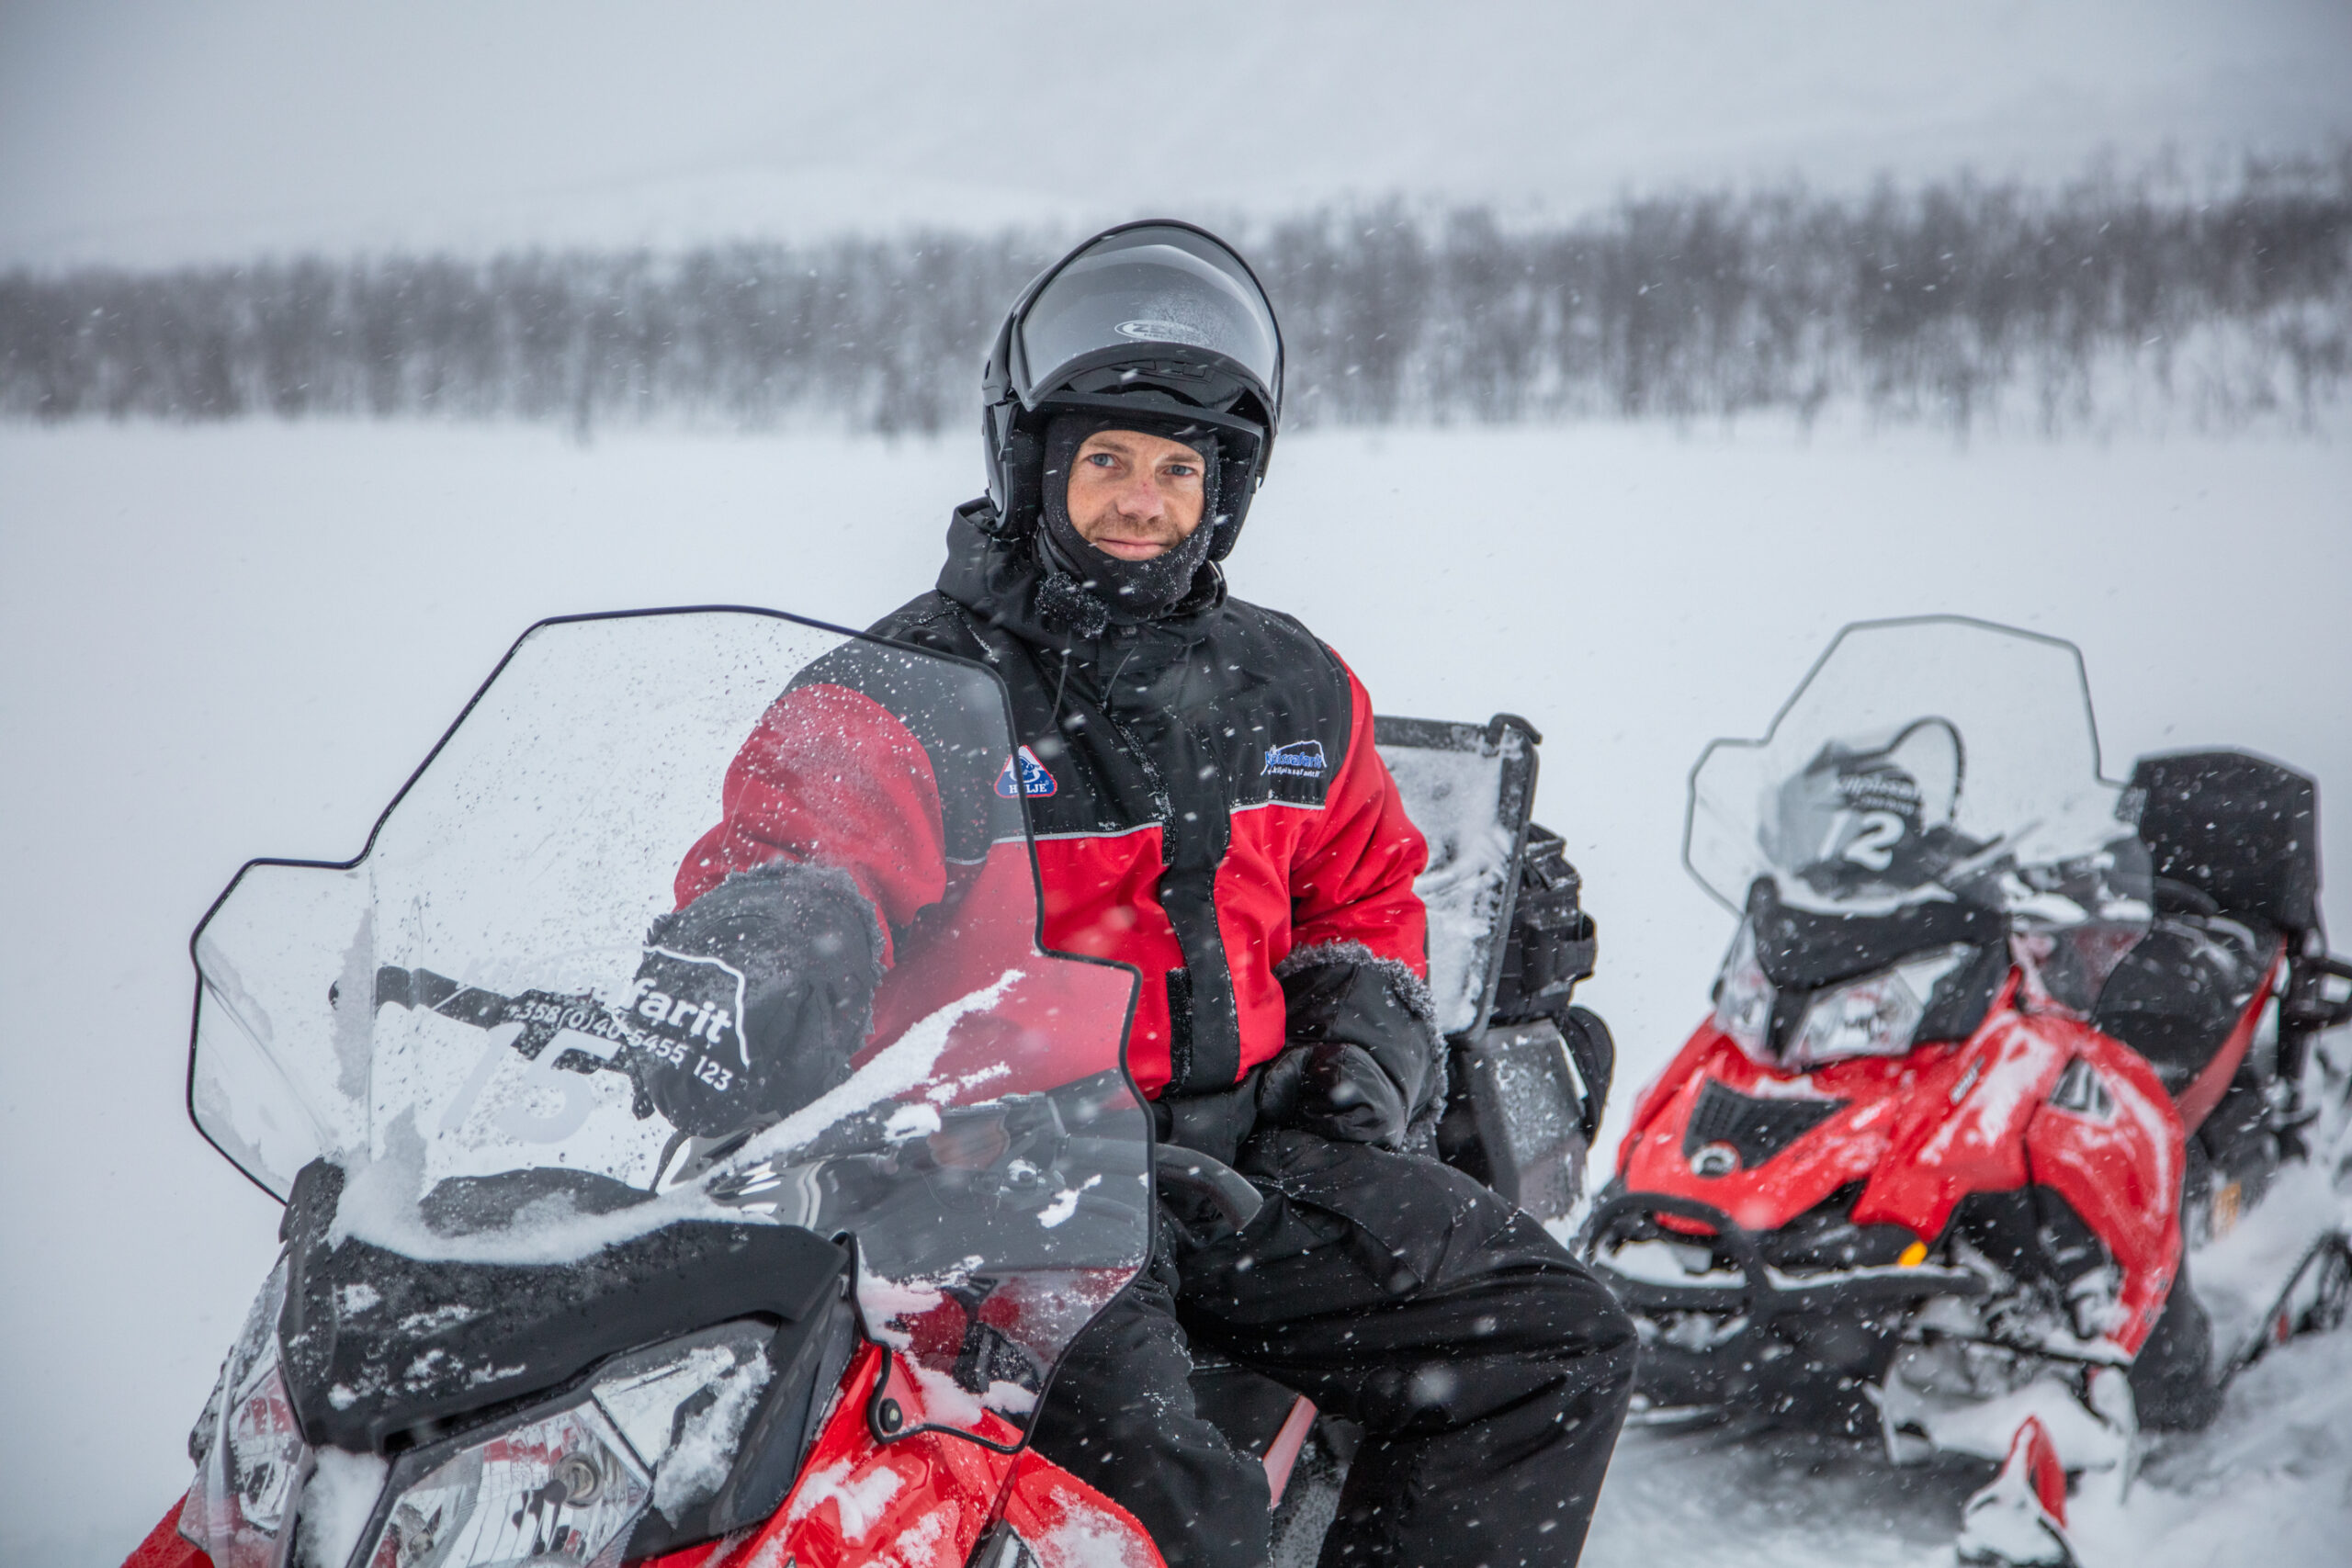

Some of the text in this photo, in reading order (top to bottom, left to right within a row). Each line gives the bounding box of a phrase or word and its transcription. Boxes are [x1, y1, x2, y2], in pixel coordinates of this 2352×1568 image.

[1009, 781, 1047, 794] HLJE
[1817, 810, 1905, 872] 12
[437, 1021, 621, 1145] 15
[693, 1055, 734, 1091] 123
